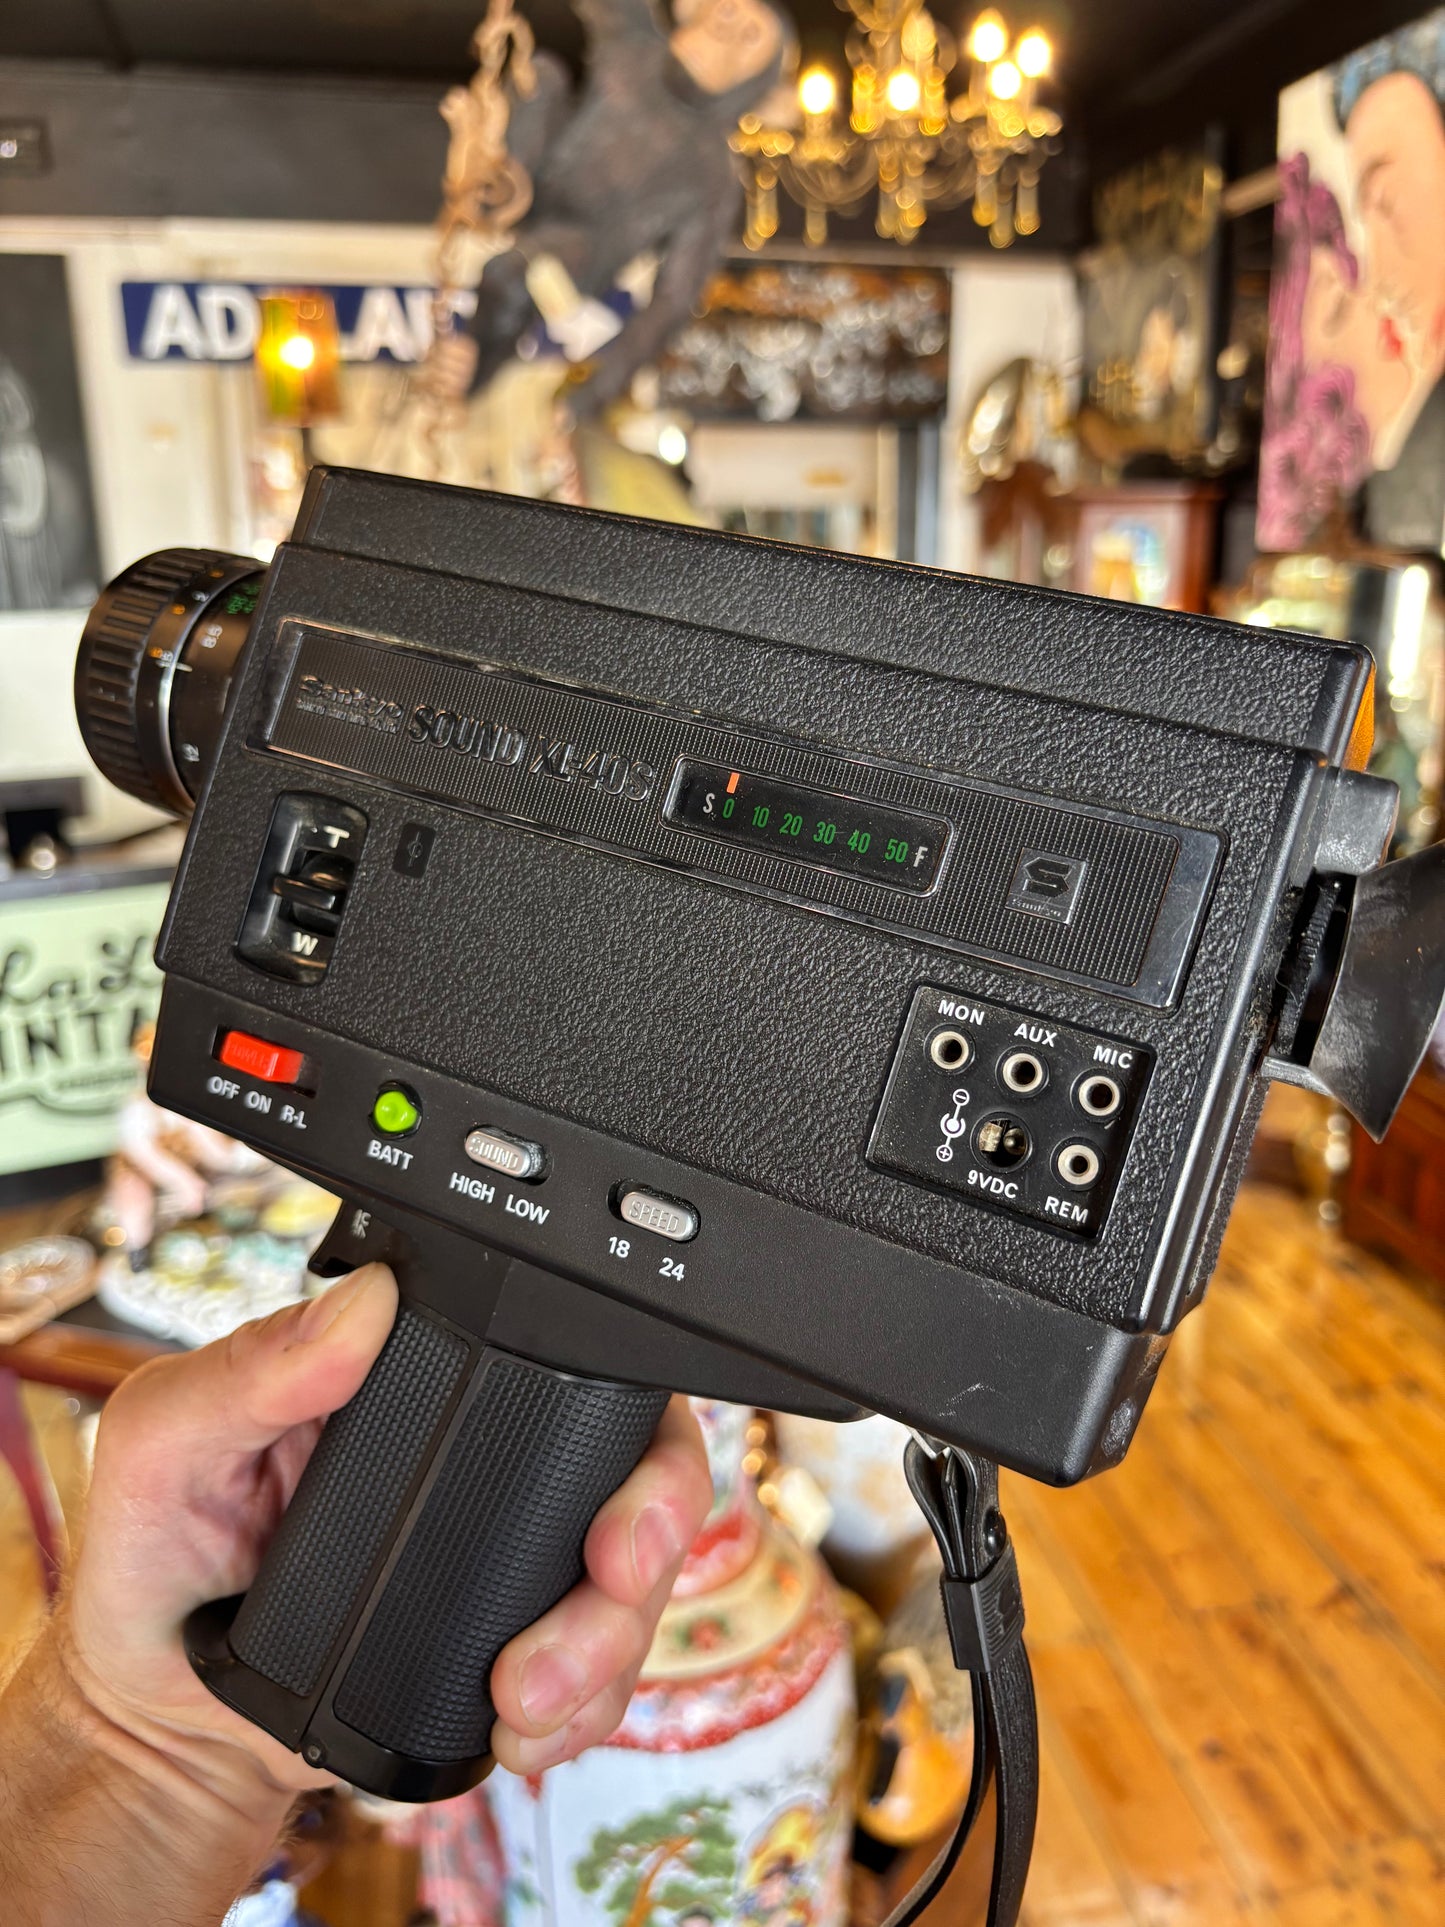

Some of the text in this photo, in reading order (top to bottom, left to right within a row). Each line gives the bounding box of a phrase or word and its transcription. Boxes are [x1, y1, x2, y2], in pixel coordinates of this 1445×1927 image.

[408, 703, 526, 767] SOUND
[529, 735, 655, 802] XL-40S
[323, 825, 350, 849] T
[702, 792, 928, 868] S 0 10 20 30 40 50 F
[292, 931, 319, 956] W
[937, 999, 985, 1026] MON
[1013, 1022, 1058, 1048] AUX
[1092, 1044, 1133, 1070] MIC
[207, 1075, 308, 1130] OFF ON R-L
[366, 1139, 414, 1171] BATT
[468, 1136, 520, 1171] SOUND
[449, 1171, 551, 1226] HIGH LOW
[966, 1169, 1019, 1199] 9VDC
[628, 1200, 681, 1234] SPEED
[1044, 1195, 1089, 1224] REM
[608, 1235, 686, 1282] 18 24
